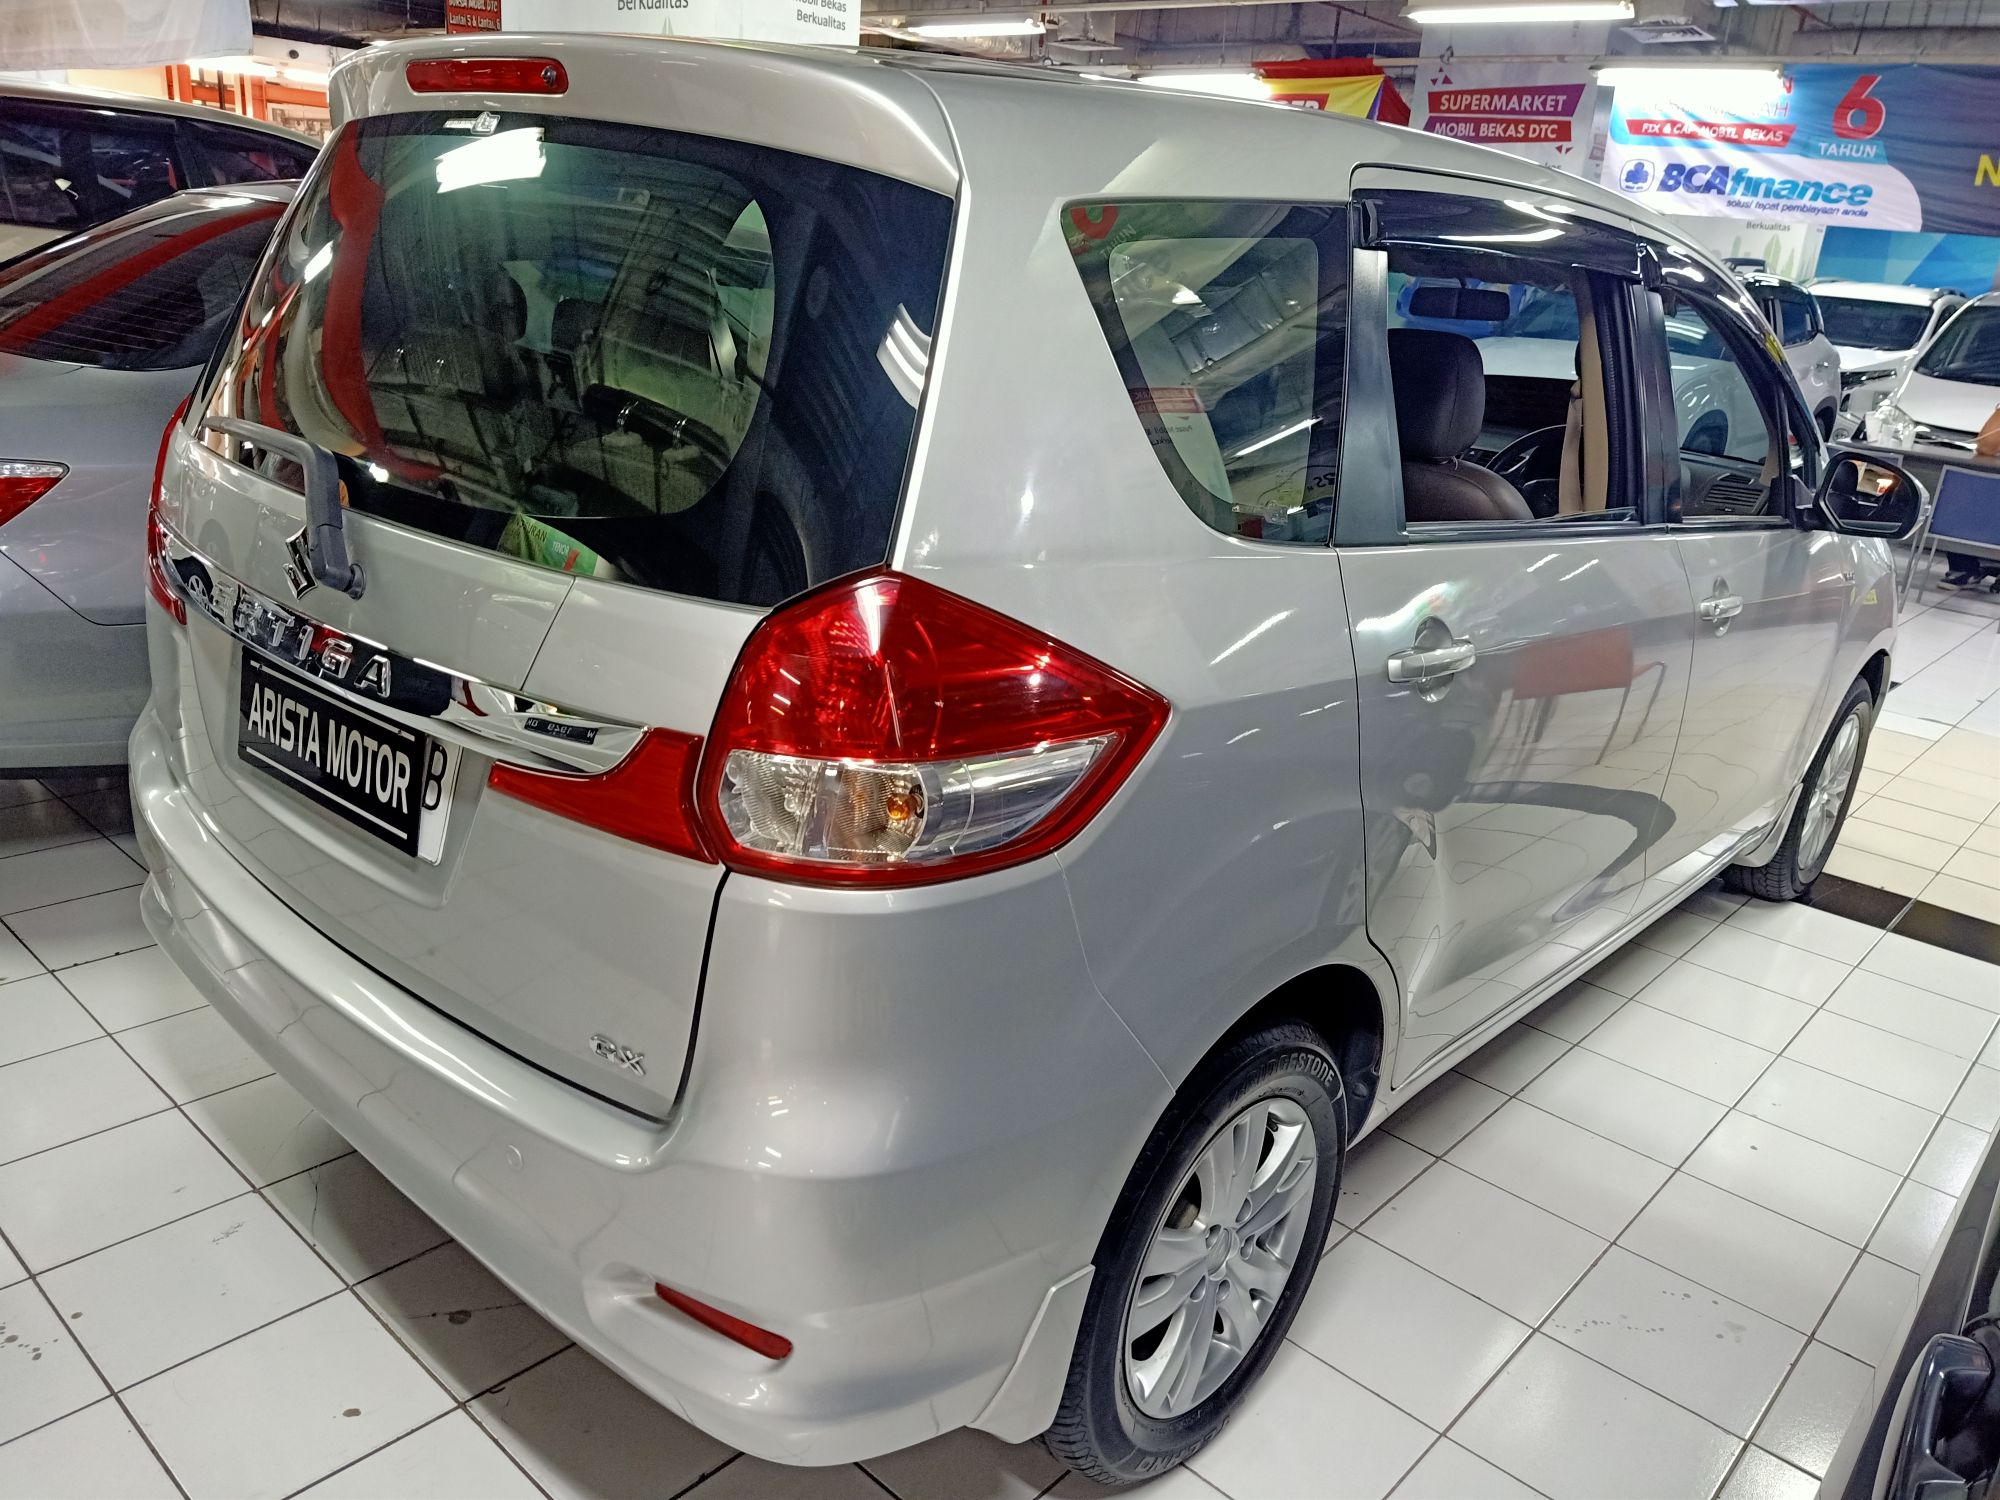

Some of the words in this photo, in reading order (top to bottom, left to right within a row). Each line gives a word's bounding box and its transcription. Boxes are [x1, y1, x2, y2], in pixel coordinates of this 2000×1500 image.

[796, 9, 846, 31] Berkualitas
[1440, 94, 1567, 112] SUPERMARKET
[1833, 73, 1886, 140] 6
[1434, 121, 1476, 138] MOBIL
[1479, 122, 1526, 139] BEKAS
[1528, 124, 1558, 139] DTC
[1641, 122, 1660, 133] FIX
[1743, 128, 1784, 142] BEKAS
[1818, 142, 1877, 158] TAHUN
[1726, 199, 1753, 209] solusi
[1746, 221, 1791, 232] Berkualitas
[211, 579, 392, 699] ERTIGA
[247, 682, 321, 769] ARISTA
[326, 719, 411, 814] MOTOR
